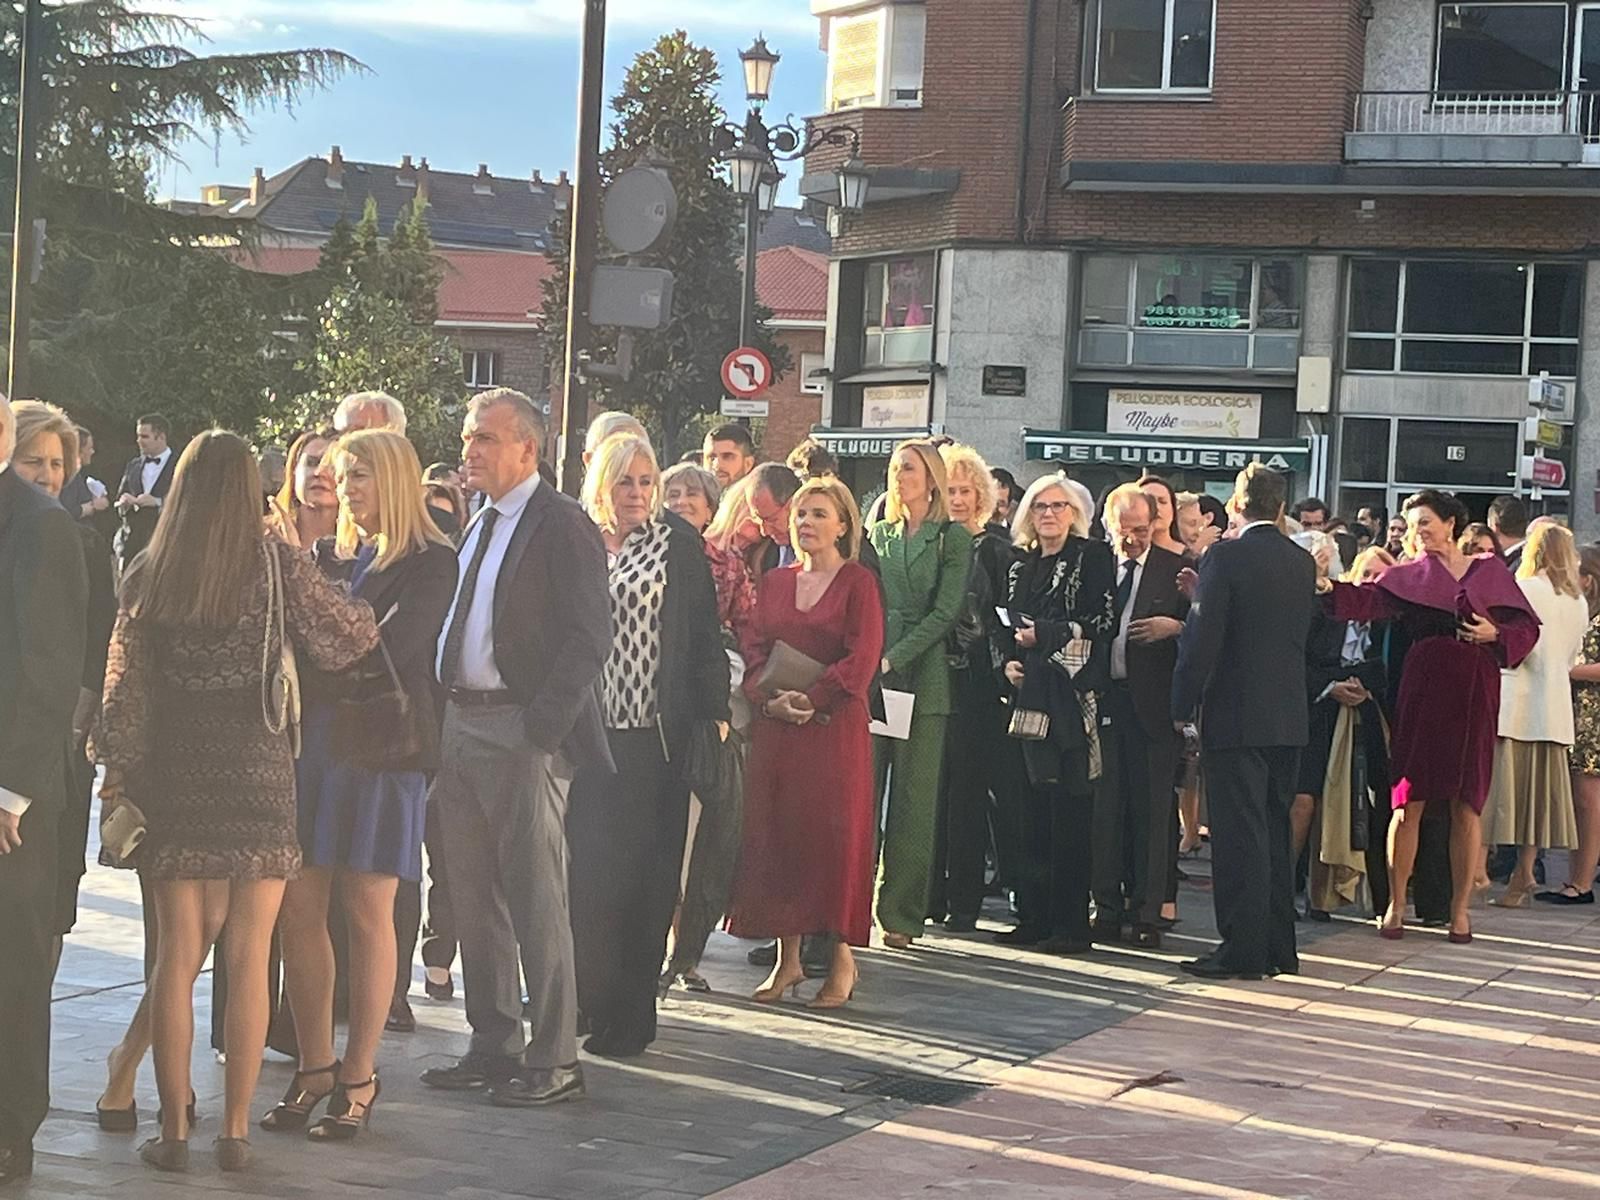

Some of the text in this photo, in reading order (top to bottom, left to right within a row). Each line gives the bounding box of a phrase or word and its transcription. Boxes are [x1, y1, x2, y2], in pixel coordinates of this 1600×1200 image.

[1183, 393, 1254, 409] ECOLOGICA
[1125, 407, 1179, 433] Maybe
[1043, 444, 1290, 468] PELUQUERIA
[1450, 447, 1465, 459] 16
